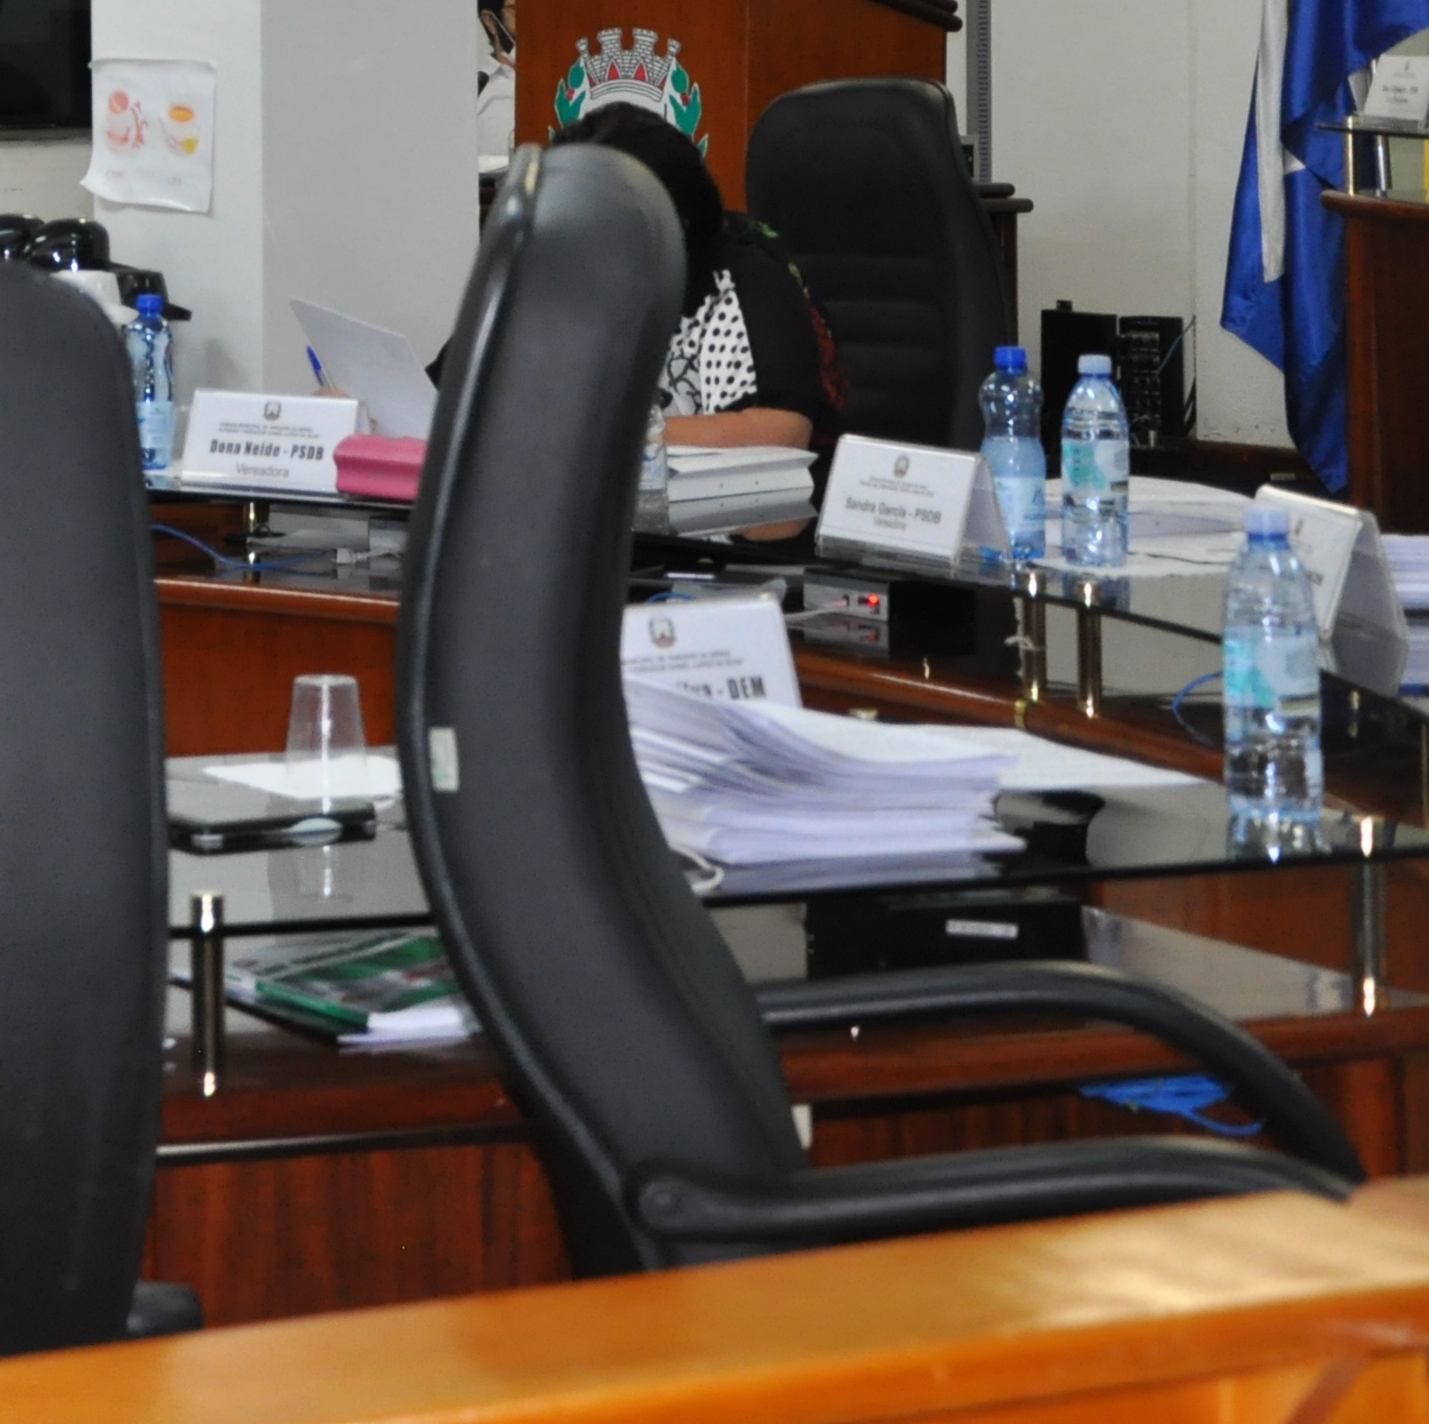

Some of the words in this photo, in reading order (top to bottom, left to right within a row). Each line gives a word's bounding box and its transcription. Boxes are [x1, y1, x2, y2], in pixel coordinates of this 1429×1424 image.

[210, 438, 241, 455] Dona
[243, 441, 280, 457] Neide
[291, 444, 324, 461] PSDB
[236, 463, 290, 478] Vereadora
[846, 496, 876, 514] Sandra
[915, 507, 941, 524] PSDB
[727, 675, 767, 699] DEM
